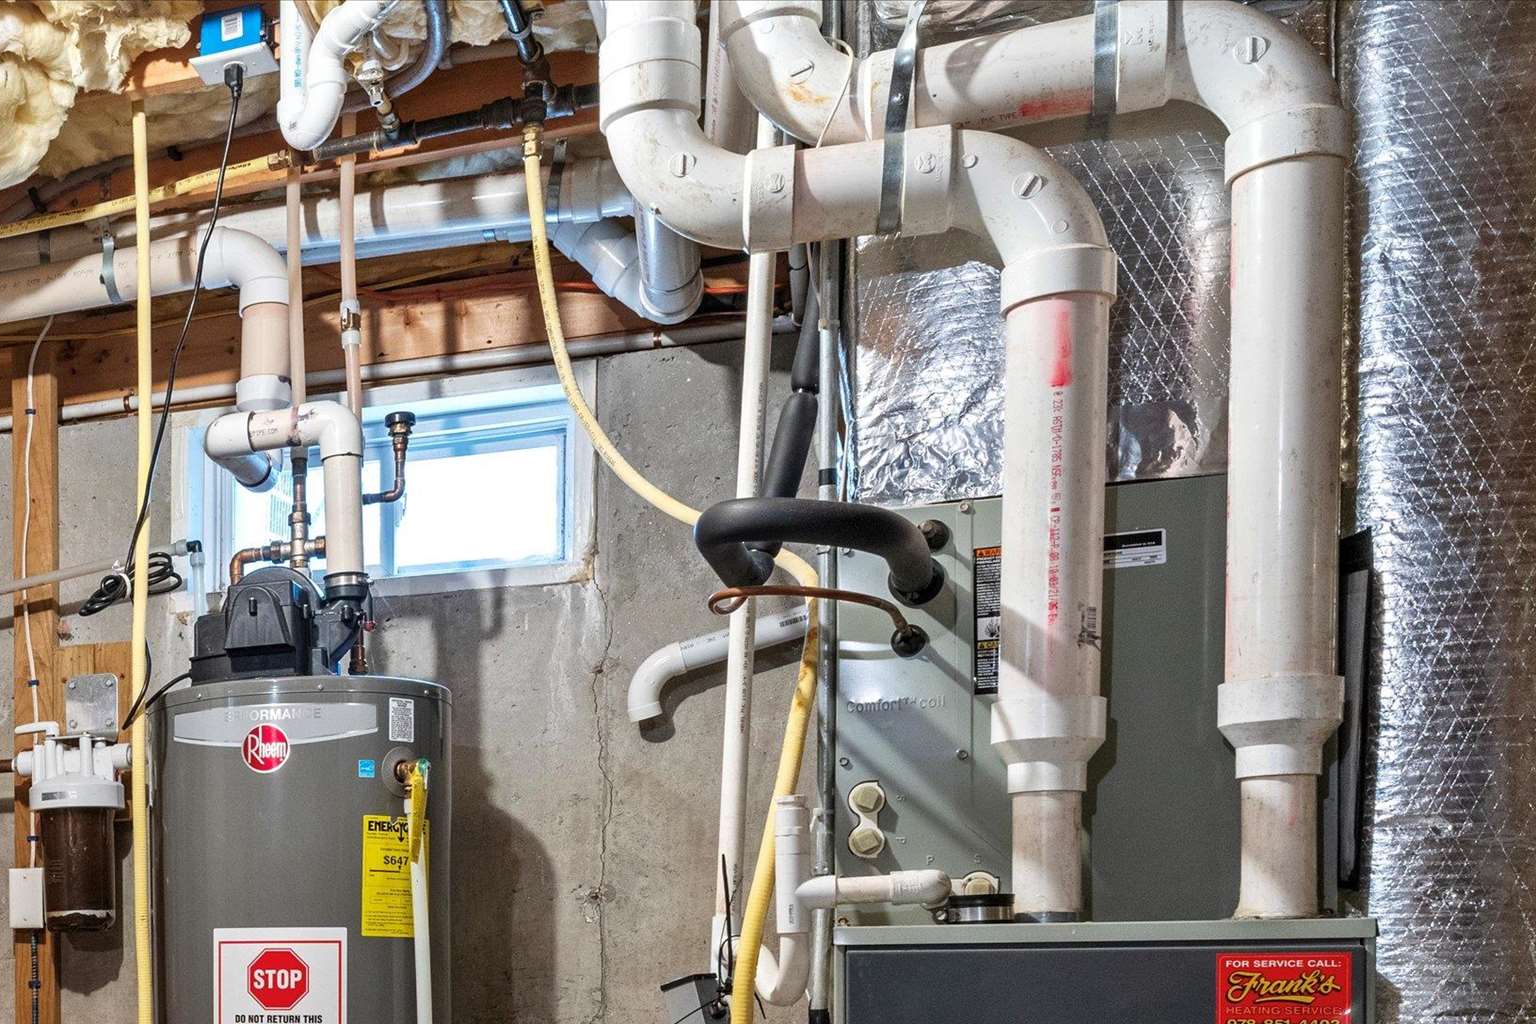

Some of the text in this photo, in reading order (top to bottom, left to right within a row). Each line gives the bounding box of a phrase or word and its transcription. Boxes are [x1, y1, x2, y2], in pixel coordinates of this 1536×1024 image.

[248, 725, 286, 765] Rheem
[1225, 959, 1342, 968] FOR SERVICE CALL:
[253, 969, 303, 990] STOP
[1227, 970, 1341, 1003] Frank's
[1226, 1006, 1342, 1016] HEATING SERVICE
[235, 1014, 323, 1024] DO NOT RETURN THIS
